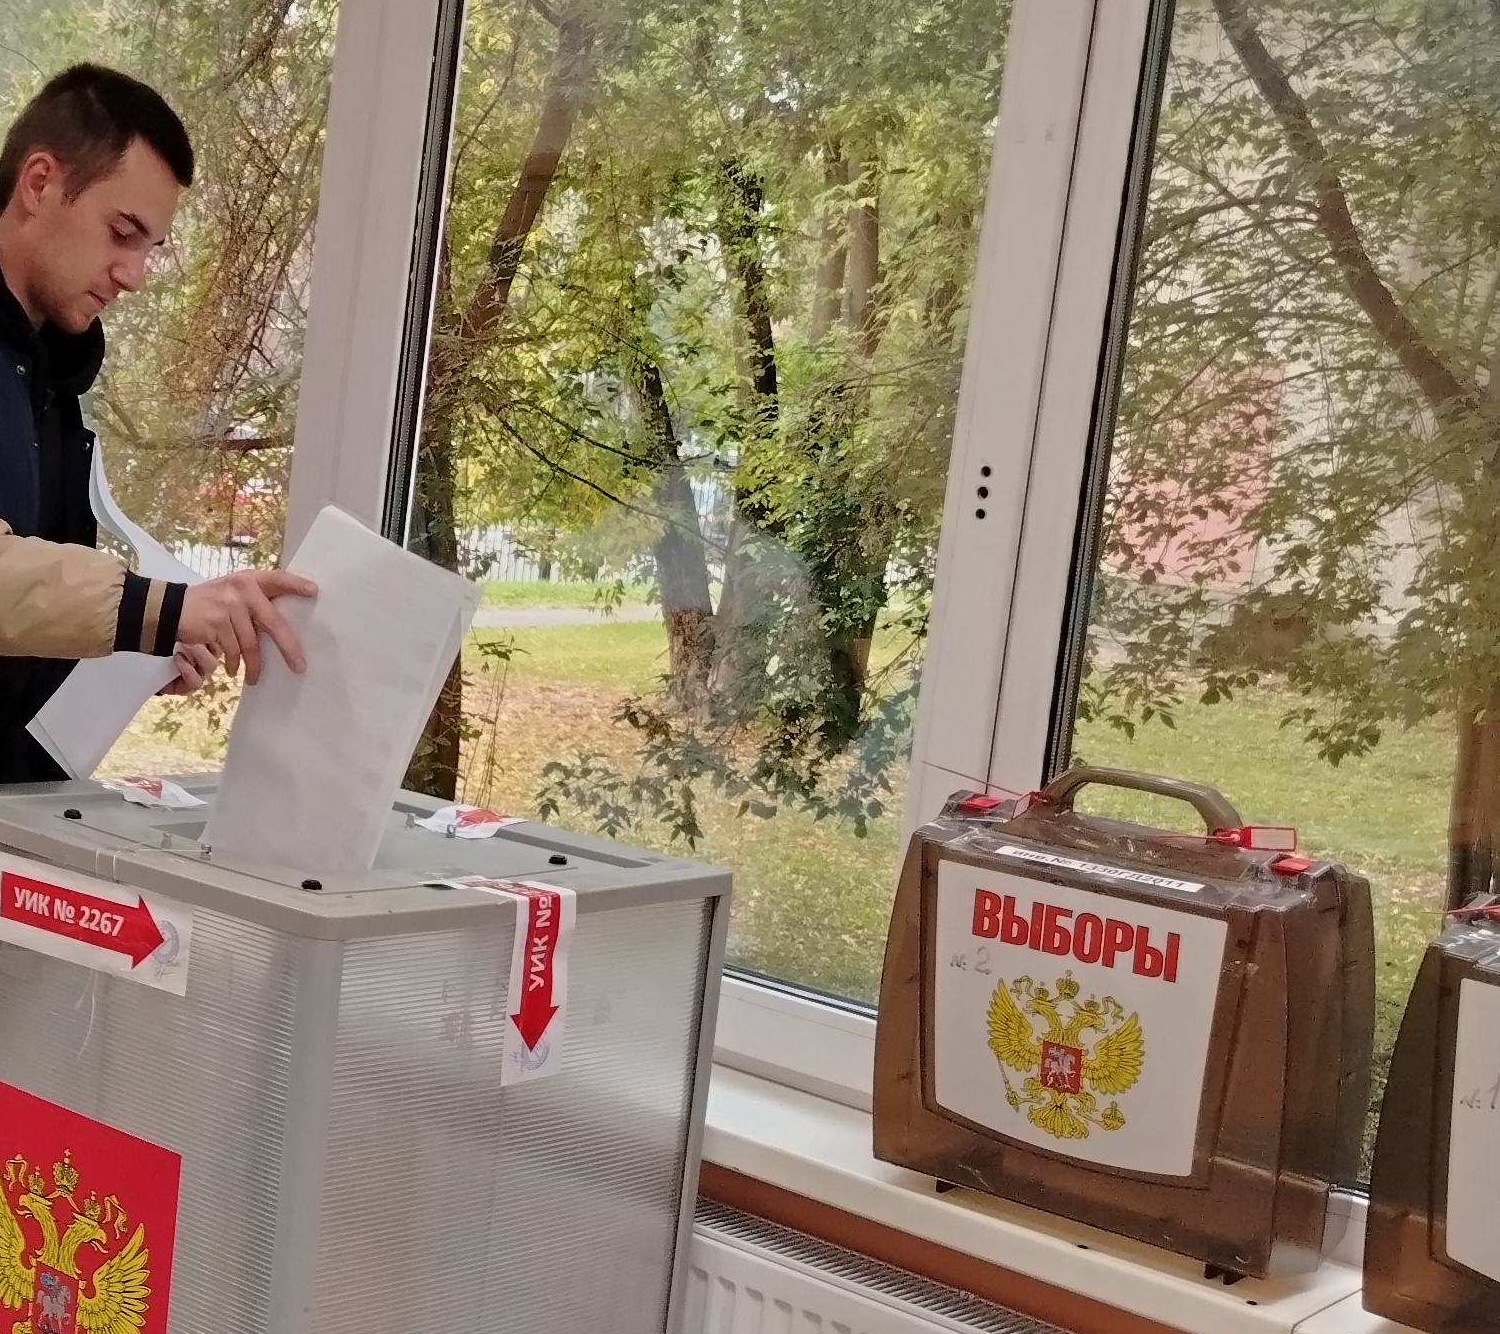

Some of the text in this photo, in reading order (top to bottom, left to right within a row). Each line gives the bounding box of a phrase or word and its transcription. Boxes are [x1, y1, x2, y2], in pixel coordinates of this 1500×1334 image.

[13, 886, 125, 937] УИК № 2267
[529, 895, 551, 992] УИК №
[972, 888, 1181, 983] ВЫБОРЫ
